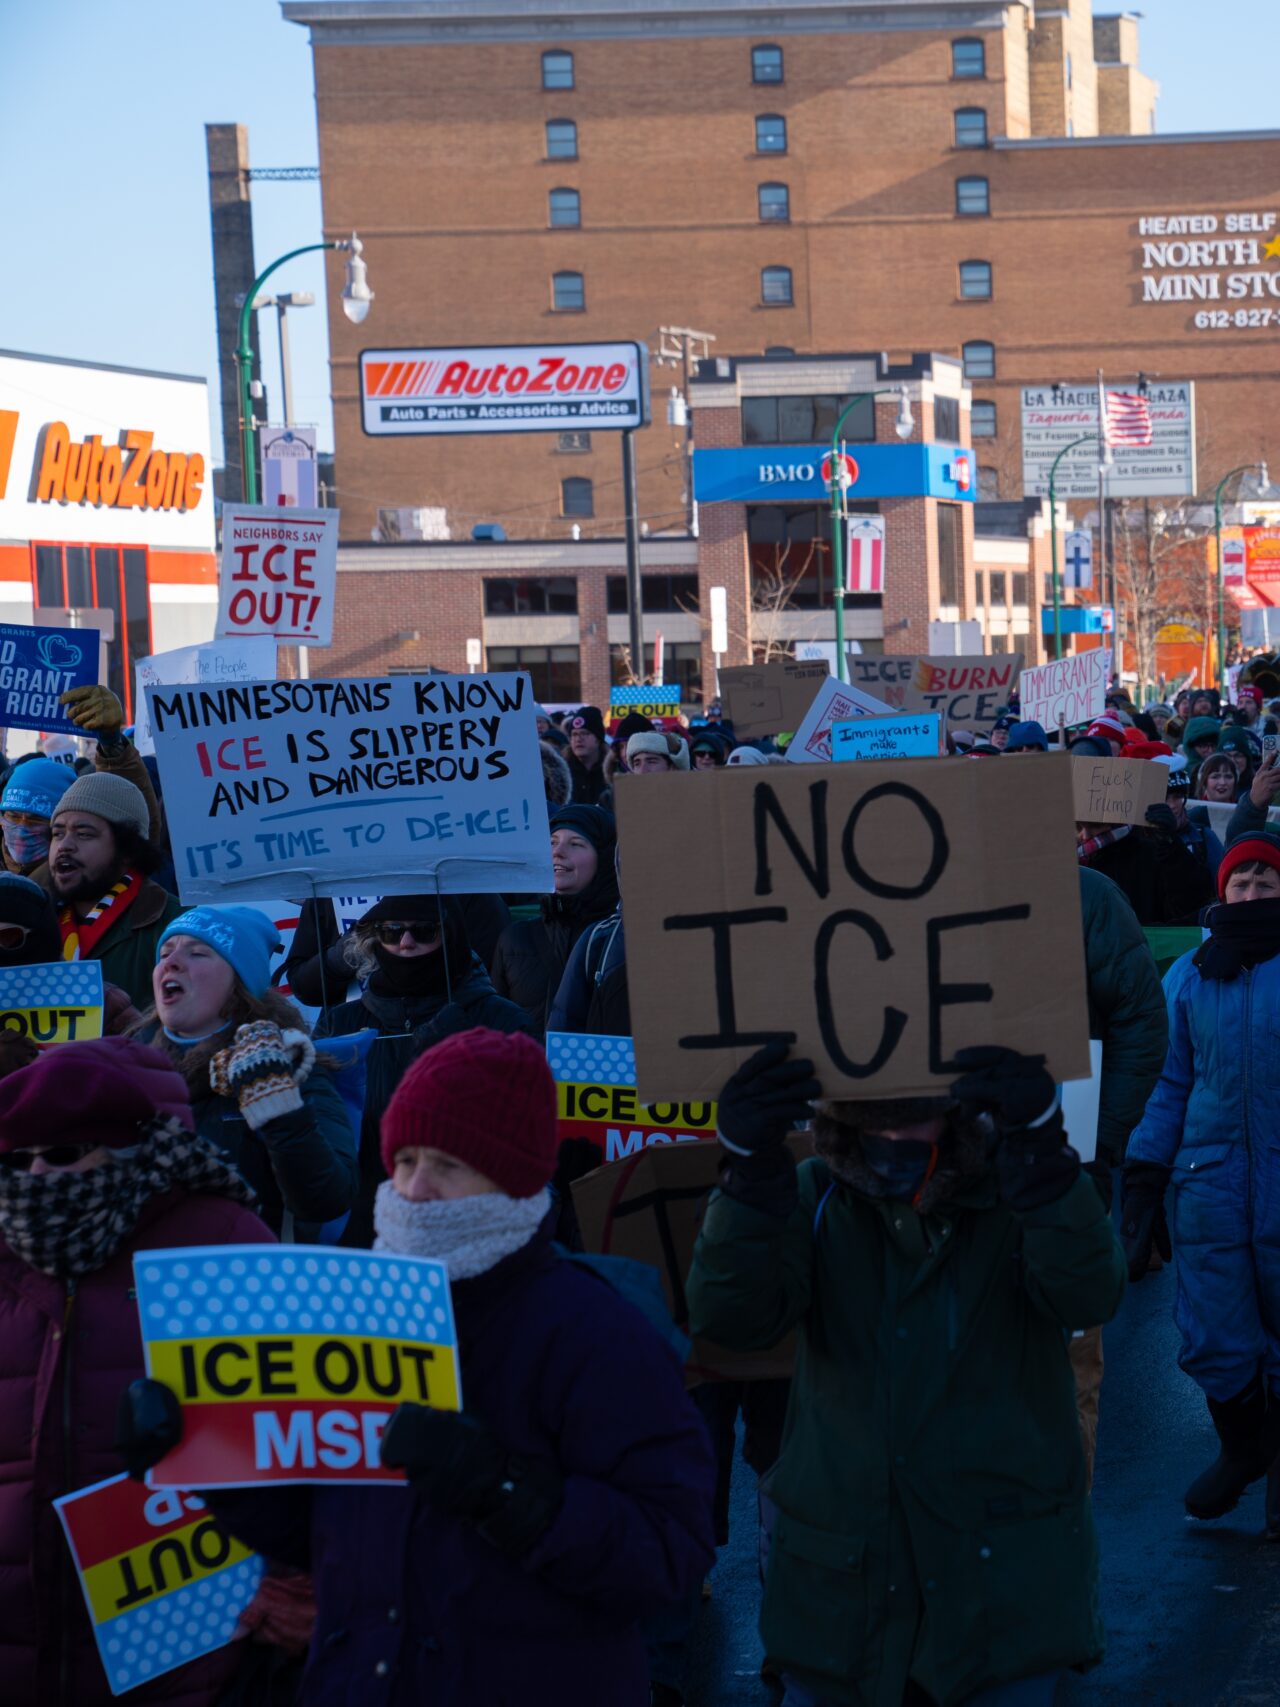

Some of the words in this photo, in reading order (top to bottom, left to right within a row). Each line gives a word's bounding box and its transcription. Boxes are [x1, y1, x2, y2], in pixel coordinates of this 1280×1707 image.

[1139, 215, 1217, 235] HEATED
[1225, 212, 1276, 232] SELF
[1142, 239, 1260, 268] NORTH
[1142, 273, 1220, 301] MINI
[434, 357, 627, 397] AutoZone
[389, 406, 424, 420] Auto
[428, 406, 467, 419] Parts
[478, 404, 568, 418] Accessories
[579, 402, 629, 416] Advice
[1024, 391, 1045, 406] LA
[36, 421, 205, 511] AutoZone
[758, 463, 815, 482] BMO
[233, 527, 299, 542] NEIGHBORS
[302, 529, 323, 543] SAY
[232, 544, 316, 588] ICE
[228, 589, 322, 632] OUT!
[215, 656, 248, 678] People
[854, 660, 912, 682] ICE
[928, 664, 1012, 692] BURN
[1023, 651, 1103, 704] IMMIGRANTS
[151, 681, 392, 732] MINNESOTANS
[414, 677, 524, 715] KNOW
[611, 704, 638, 717] ICE
[642, 704, 678, 716] OUT
[196, 735, 267, 777] ICE
[286, 729, 331, 763] IS
[349, 716, 501, 760] SLIPPERY
[838, 724, 930, 742] Immigrants
[870, 741, 897, 750] make
[208, 777, 289, 817] AND
[309, 751, 510, 797] DANGEROUS
[1091, 766, 1133, 788] Fuck
[1088, 789, 1133, 817] Trump
[185, 838, 243, 877] IT'S
[255, 827, 331, 862] TIME
[343, 823, 386, 848] TO
[754, 779, 950, 900] NO
[663, 903, 1040, 1079] ICE
[0, 1009, 86, 1041] OUT
[566, 1085, 637, 1121] ICE
[647, 1101, 711, 1127] OU
[180, 1341, 297, 1398] ICE
[313, 1340, 435, 1400] OUT
[116, 1517, 233, 1611] OUT
